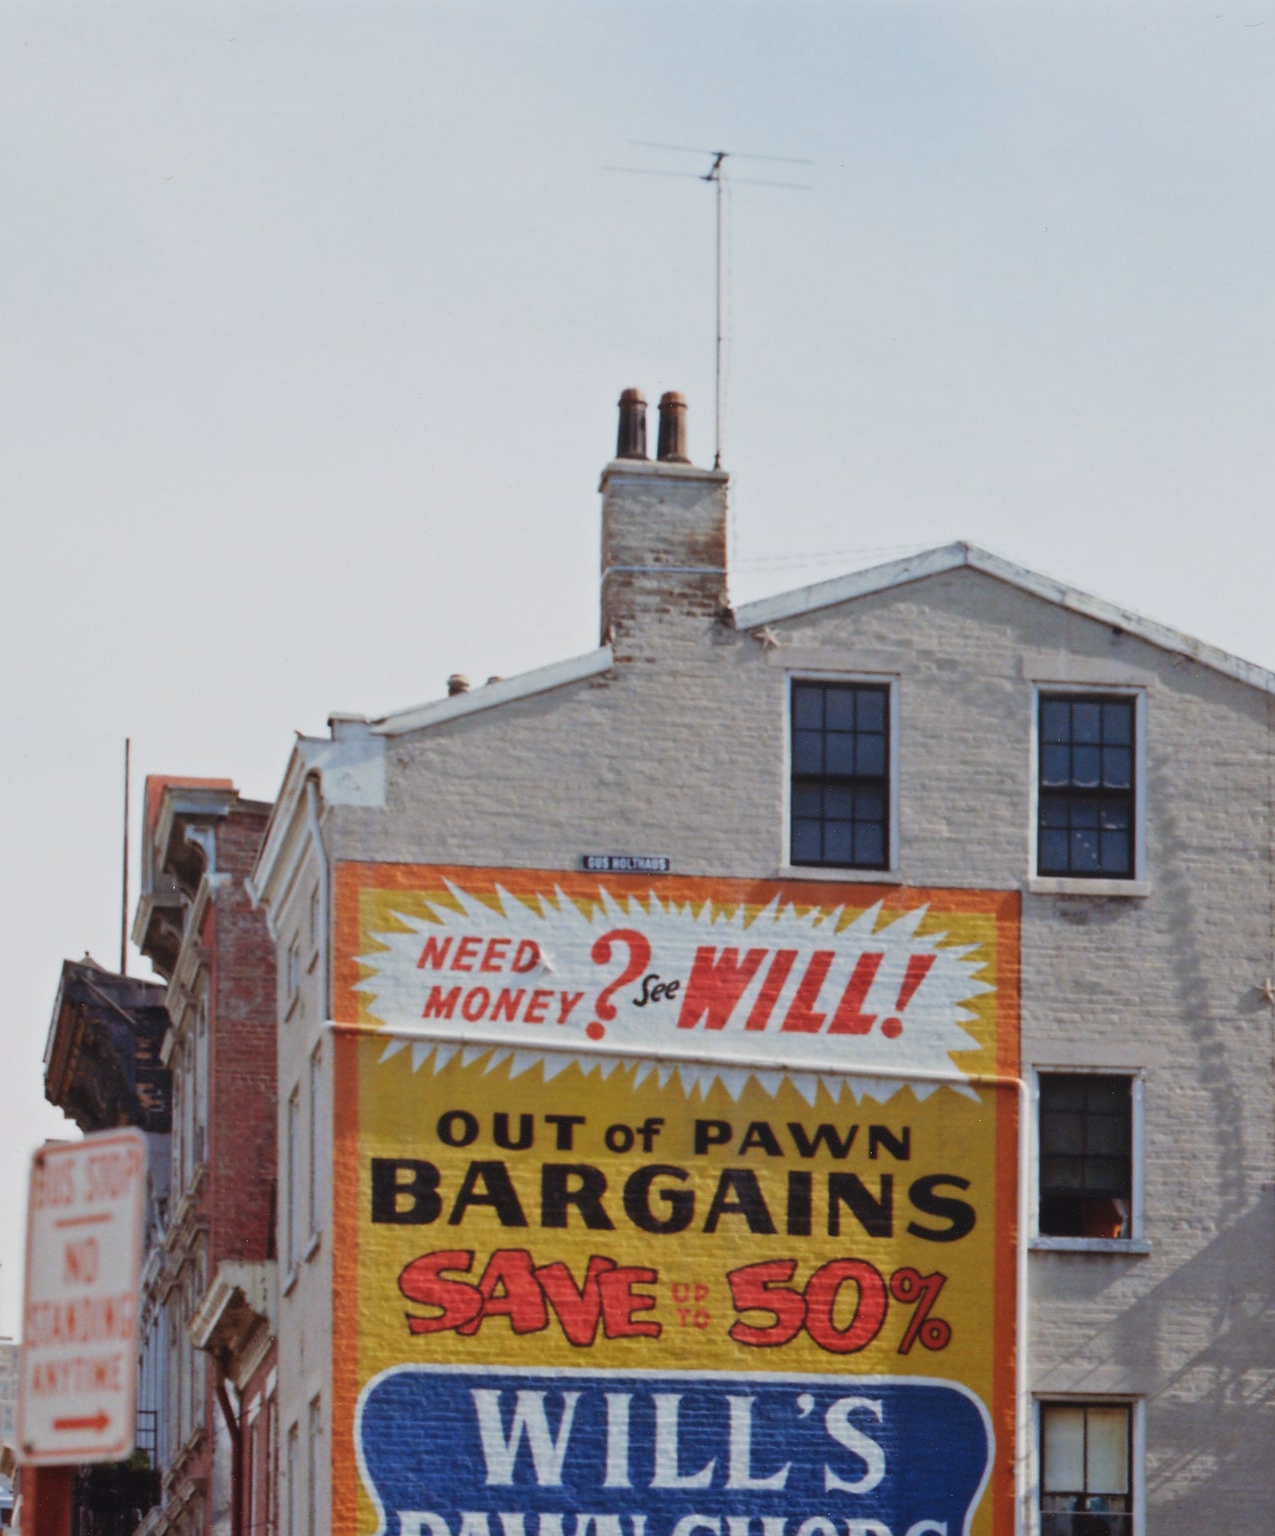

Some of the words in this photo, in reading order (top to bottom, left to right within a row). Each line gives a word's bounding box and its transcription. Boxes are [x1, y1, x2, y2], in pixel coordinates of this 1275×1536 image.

[417, 935, 540, 975] NEED
[633, 973, 682, 1008] See
[675, 945, 938, 1040] WILL!
[436, 1110, 586, 1152] OUT
[604, 1117, 665, 1153] of
[693, 1118, 912, 1162] PAWN
[33, 1156, 77, 1210] BUS
[83, 1149, 143, 1202] STOP
[369, 1158, 978, 1243] BARGAINS
[63, 1236, 100, 1286] NO
[27, 1292, 135, 1348] STANDING
[397, 1248, 663, 1349] SAVE
[726, 1256, 952, 1356] 50%
[671, 1284, 712, 1303] UP
[675, 1310, 712, 1331] TO
[32, 1353, 123, 1398] ANYTIME
[470, 1388, 888, 1495] WILL'S
